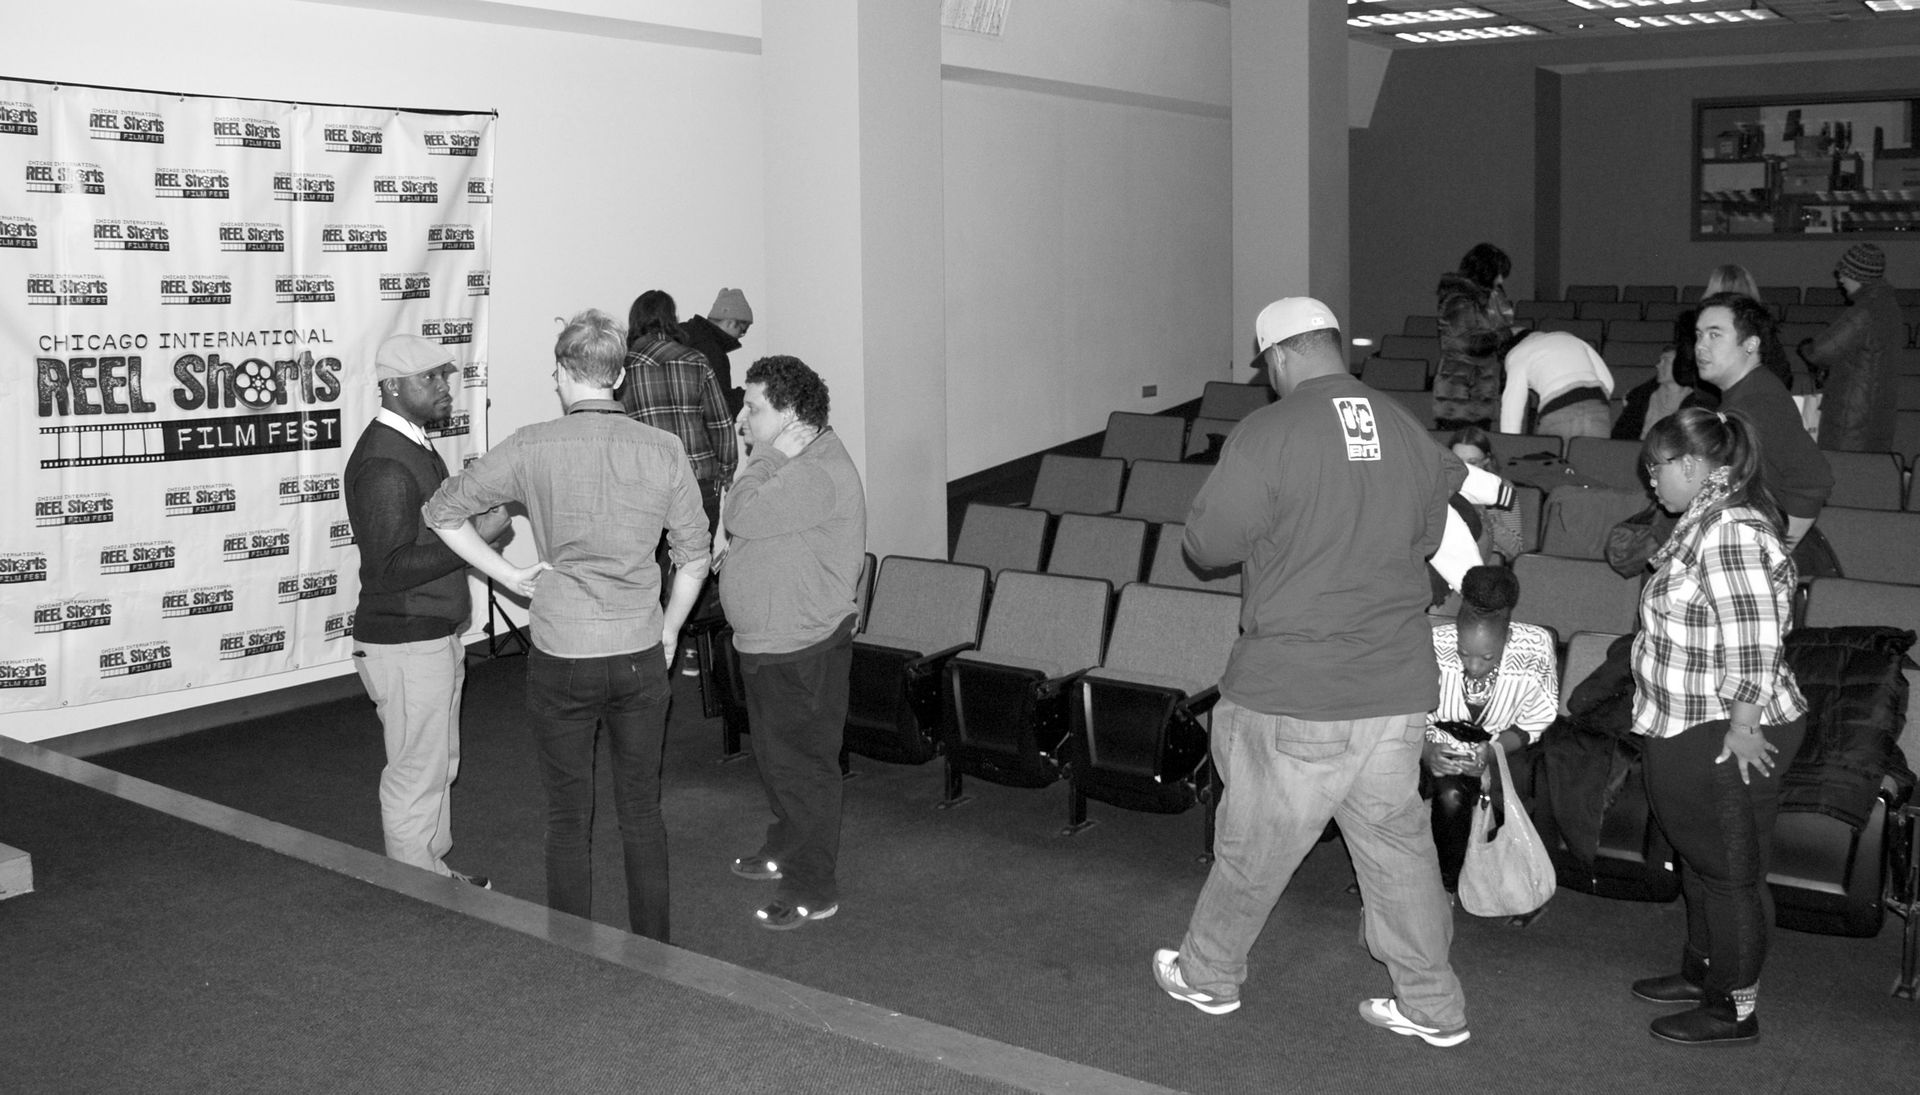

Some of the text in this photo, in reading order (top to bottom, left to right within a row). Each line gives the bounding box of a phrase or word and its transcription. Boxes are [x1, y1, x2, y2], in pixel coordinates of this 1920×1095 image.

[0, 106, 38, 123] horts
[18, 126, 37, 134] FEST
[90, 114, 164, 132] REEL Shorts
[214, 122, 280, 138] REEL Shorts
[123, 133, 143, 141] FILM
[324, 129, 348, 142] REEL
[424, 135, 448, 146] REEL
[26, 166, 53, 181] REEL
[155, 173, 229, 188] REEL Shorts
[86, 185, 104, 193] FEST
[273, 176, 335, 192] REEL Shorts
[374, 180, 438, 193] REEL Shorts
[468, 181, 486, 194] REEL
[209, 190, 228, 198] FEST
[0, 221, 38, 237] horts
[94, 224, 169, 240] REEL Shorts
[220, 227, 284, 241] REEL Shorts
[323, 229, 387, 242] REEL Shorts
[428, 228, 474, 241] REEL Shorts
[150, 242, 169, 250] FEST
[28, 279, 107, 294] REEL Shorts
[161, 280, 231, 295] REEL Shorts
[275, 279, 334, 293] REEL Shorts
[380, 278, 402, 291] REEL
[467, 275, 484, 287] REEL
[422, 323, 442, 336] REEL
[38, 329, 334, 351] CHICAGO INTERNATIONAL
[463, 366, 480, 379] REEL
[36, 350, 342, 417] REEL Shorts
[178, 418, 337, 450] FILM FEST
[279, 477, 339, 496] REEL Shorts
[165, 488, 236, 506] REEL Shorts
[302, 491, 339, 501] FILM FEST
[36, 497, 113, 516] REEL Shorts
[195, 503, 235, 513] FILM FEST
[67, 512, 113, 523] FILM FEST
[330, 524, 351, 538] REEL
[223, 533, 290, 551] REEL Shorts
[100, 546, 175, 564] REEL Shorts
[251, 547, 289, 558] FILM FEST
[132, 560, 174, 571] FILM FEST
[23, 572, 46, 580] FEST
[278, 580, 300, 594] REEL
[303, 574, 338, 590] Shorts
[162, 589, 233, 609] REEL Shorts
[301, 586, 337, 598] FILM FEST
[34, 603, 112, 623] REEL Shorts
[192, 602, 233, 614] FILM FEST
[66, 616, 111, 628] FILM FEST
[325, 617, 344, 632] REEL
[220, 637, 245, 651] REEL
[100, 645, 171, 668] REEL Shorts
[131, 660, 171, 673] FILM FEST
[23, 677, 46, 686] FEST
